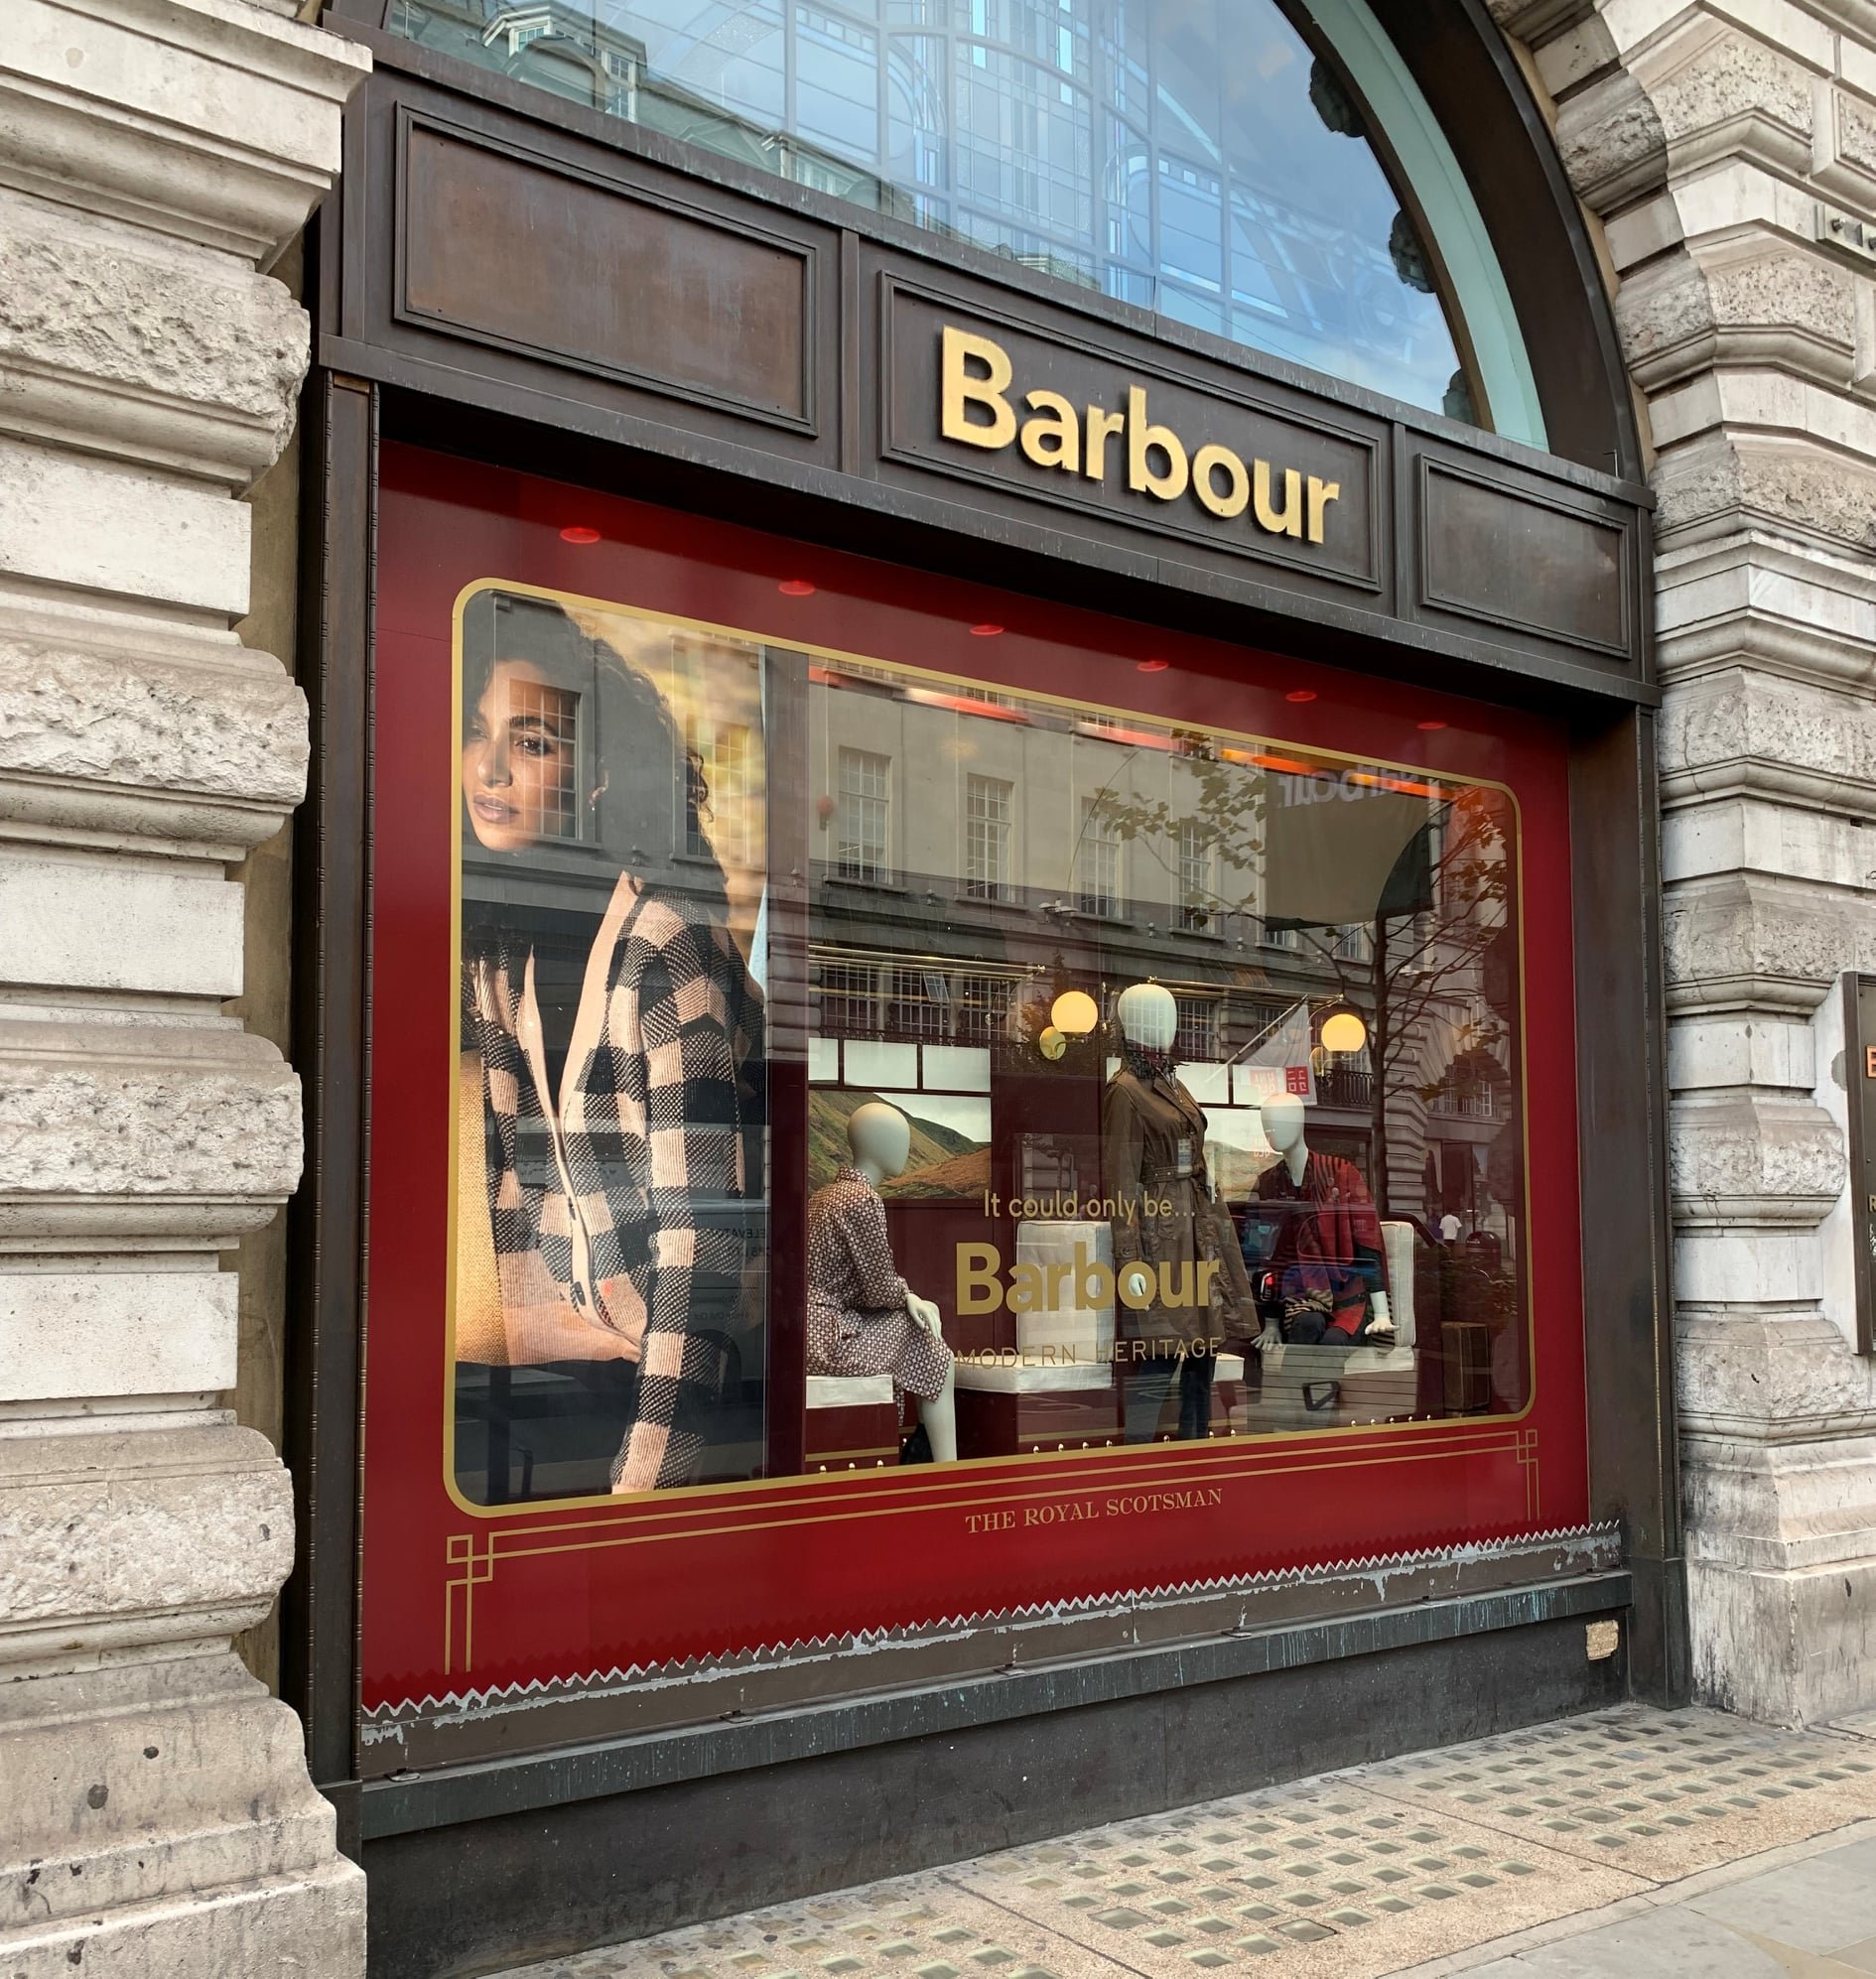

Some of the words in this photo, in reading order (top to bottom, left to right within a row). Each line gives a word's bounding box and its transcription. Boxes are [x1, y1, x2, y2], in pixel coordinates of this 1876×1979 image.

[941, 324, 1340, 545] Barbour
[984, 1190, 1001, 1218] It
[1008, 1190, 1079, 1218] could
[1086, 1190, 1136, 1226] only
[956, 1241, 1220, 1315] Barbour
[957, 1344, 1077, 1370] MODERN
[1096, 1337, 1223, 1365] HERITAGE
[965, 1511, 1015, 1534] THE
[1023, 1502, 1100, 1526] ROYAL
[1106, 1488, 1223, 1517] SCOTSMAN
